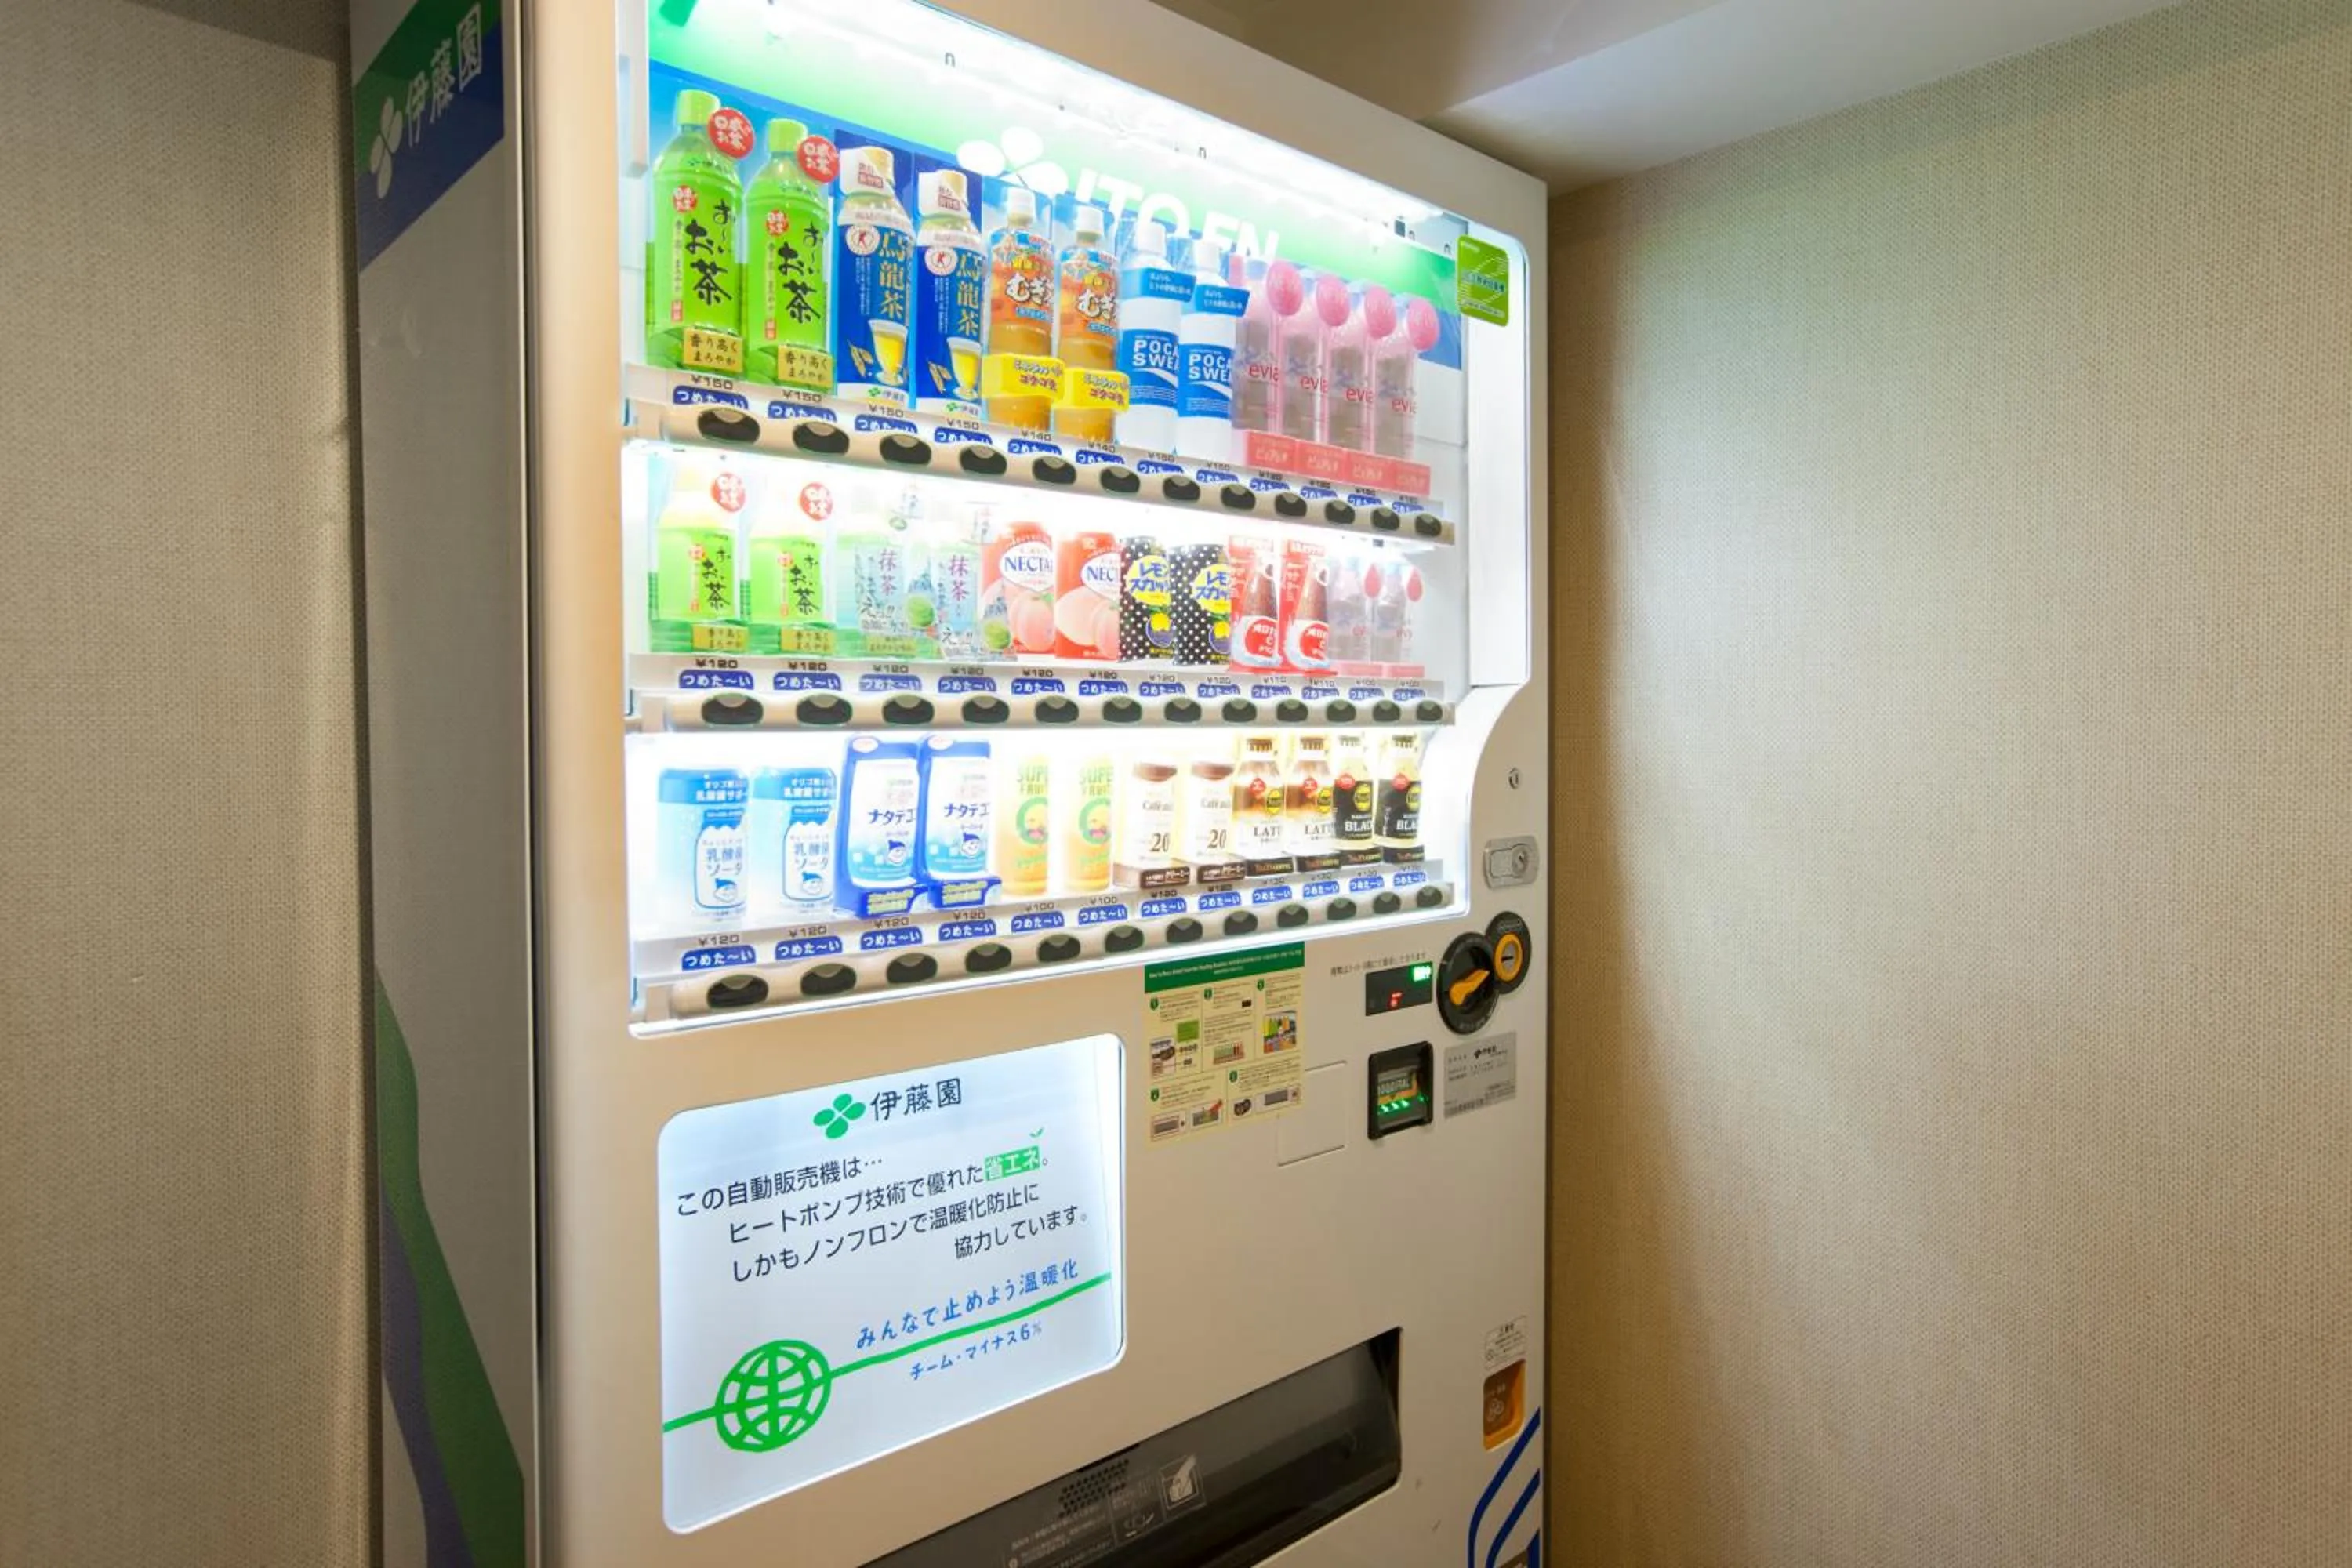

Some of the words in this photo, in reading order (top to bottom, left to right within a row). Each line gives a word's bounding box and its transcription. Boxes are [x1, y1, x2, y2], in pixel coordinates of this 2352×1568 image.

[405, 2, 482, 148] 伊藤園
[685, 218, 733, 307] お茶
[777, 241, 822, 325] お茶
[691, 333, 738, 353] 香り高く
[691, 374, 734, 390] ¥150
[783, 389, 822, 404] ¥150
[868, 404, 904, 417] ¥150
[947, 418, 979, 430] ¥150
[1004, 556, 1054, 572] NECTA
[1087, 566, 1119, 583] NEC
[702, 558, 731, 610] お茶
[789, 564, 821, 615] お茶
[695, 659, 739, 670] ¥120
[788, 661, 828, 673] ¥120
[873, 664, 909, 674] ¥120
[950, 666, 985, 676] ¥120
[681, 675, 752, 688] つめた〜い
[775, 676, 840, 690] つめた〜い
[1149, 832, 1170, 853] 20
[1207, 829, 1228, 849] 20
[953, 909, 986, 920] ¥120
[1025, 902, 1054, 911] ¥100
[1080, 908, 1126, 921] つめた〜い
[873, 916, 909, 928] ¥120
[1014, 914, 1063, 929] つめた〜い
[788, 925, 828, 938] ¥120
[941, 922, 996, 938] つめた〜い
[698, 933, 741, 946] ¥120
[862, 930, 921, 947] つめた〜い
[777, 940, 840, 957] つめた〜い
[684, 950, 754, 967] つめた〜い
[870, 1076, 963, 1123] 伊藤園
[729, 1144, 1049, 1243] ヒートポンプ技術で優れた省エネ。
[733, 1182, 1041, 1283] しかもノンフロンで温暖化防止に
[954, 1204, 1088, 1260] 協力しています。
[855, 1258, 1080, 1350] みんなで止めよう温暖化
